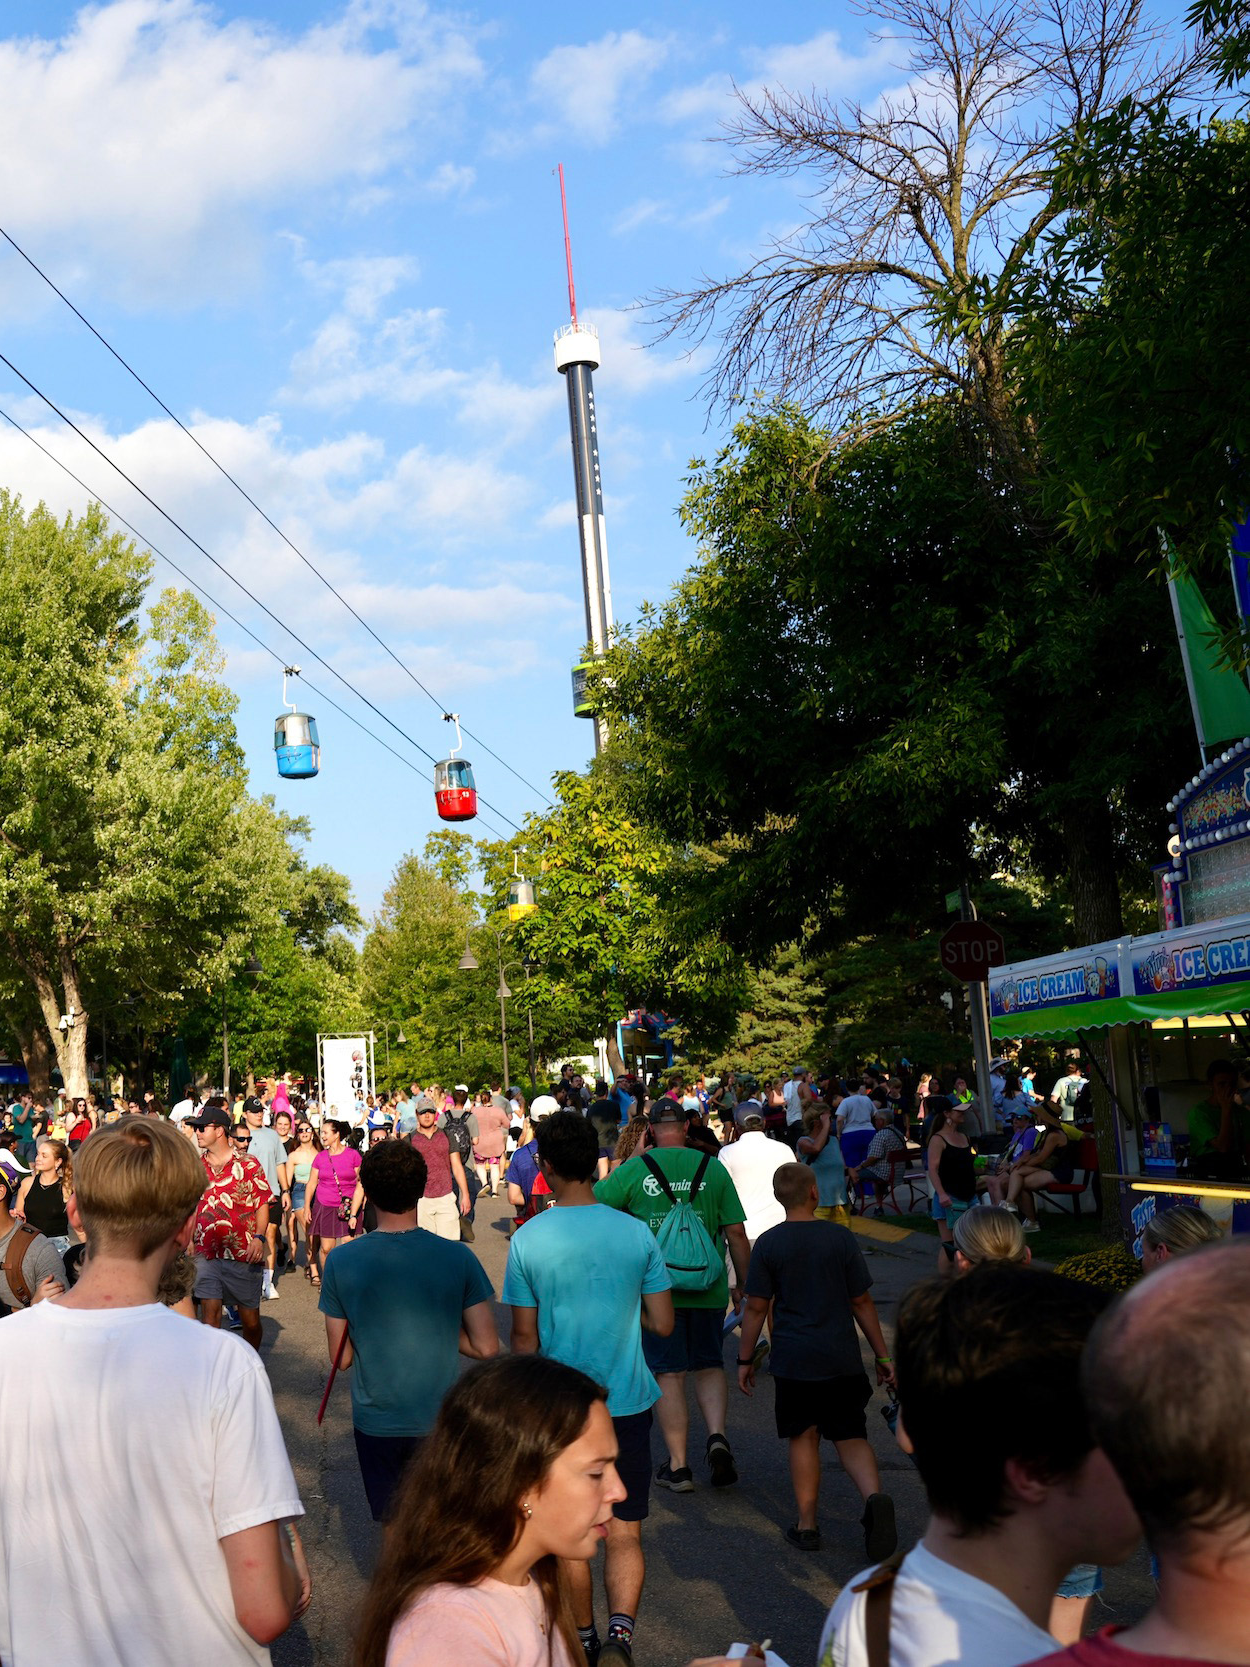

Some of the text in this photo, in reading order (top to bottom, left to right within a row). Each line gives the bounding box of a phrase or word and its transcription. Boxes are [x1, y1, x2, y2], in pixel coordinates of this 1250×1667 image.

[945, 940, 999, 963] STOP
[1172, 946, 1206, 982] ICE
[1207, 935, 1250, 976] CRE
[1017, 977, 1038, 1004] ICE
[1039, 967, 1086, 1001] CREAM
[643, 1174, 706, 1197] Rnnins
[1131, 1195, 1156, 1235] TASTE
